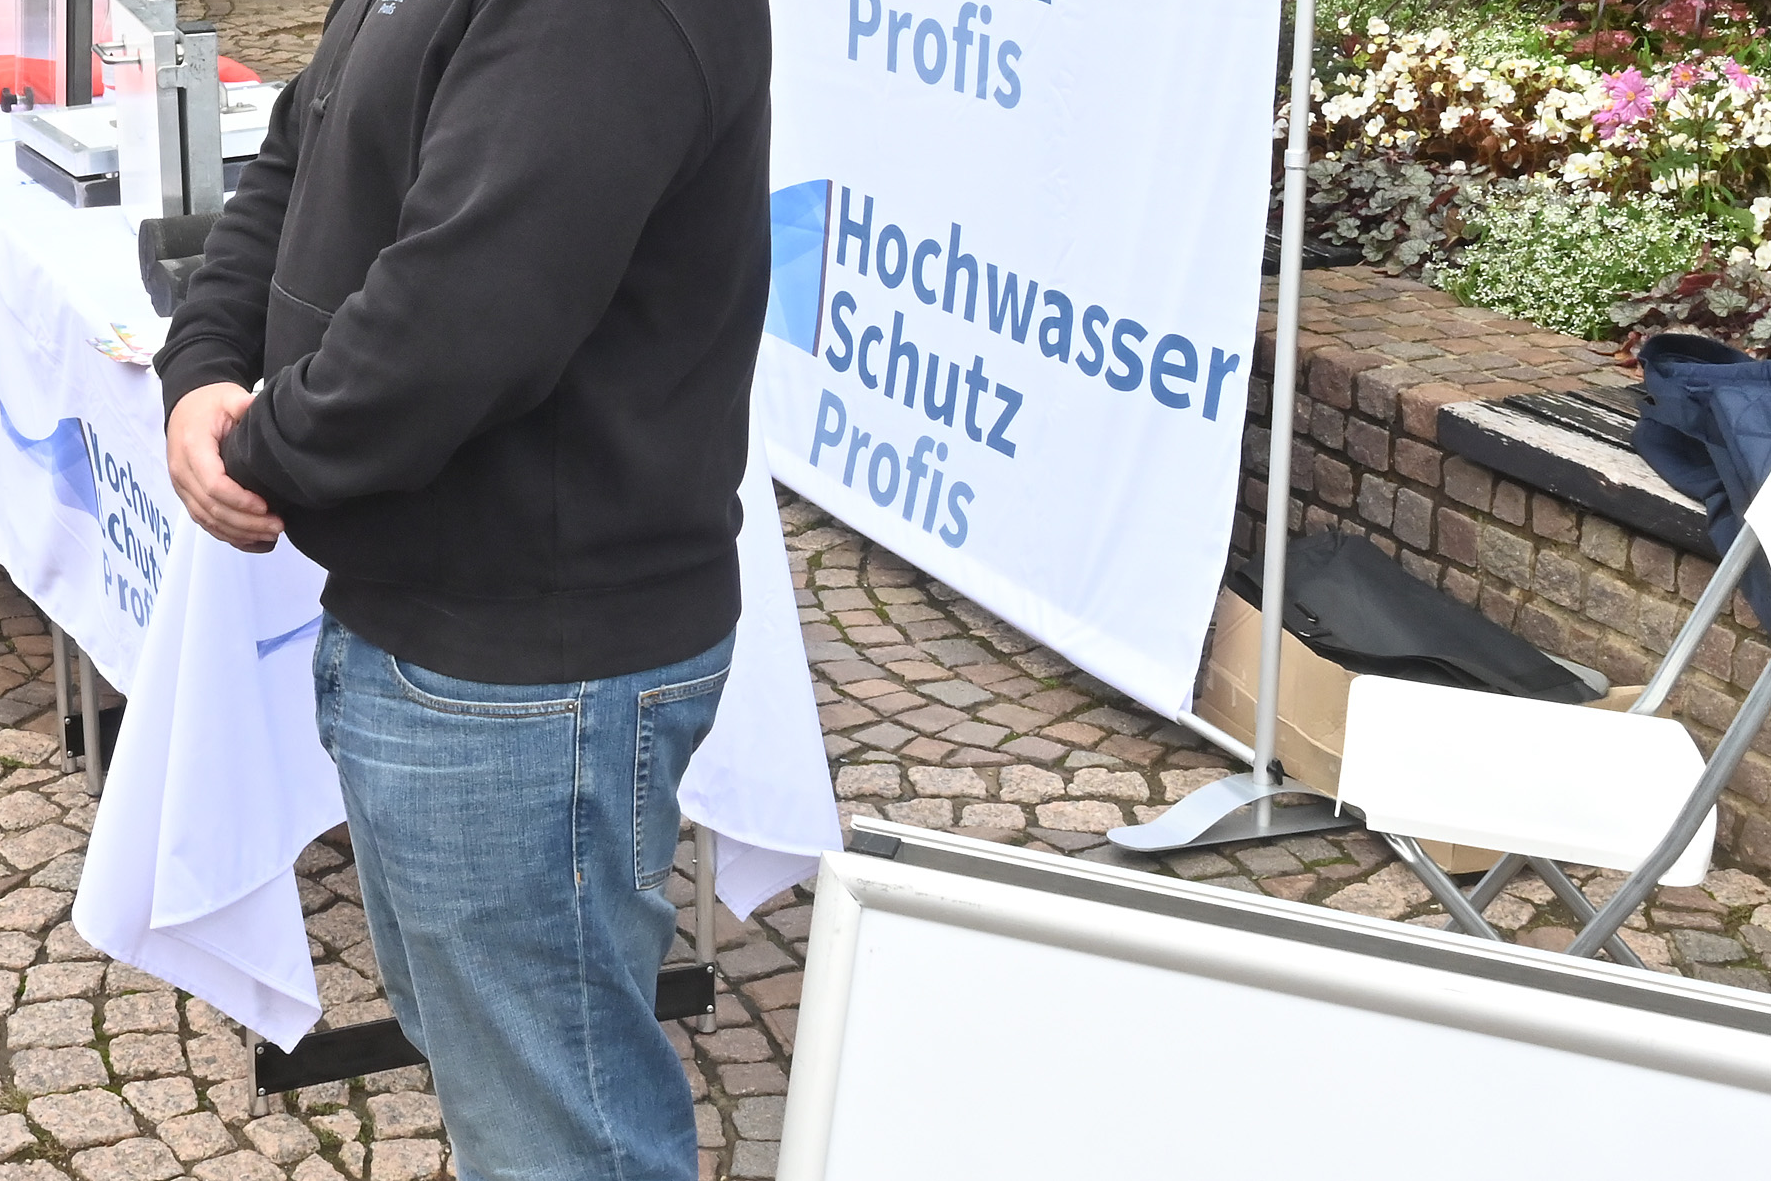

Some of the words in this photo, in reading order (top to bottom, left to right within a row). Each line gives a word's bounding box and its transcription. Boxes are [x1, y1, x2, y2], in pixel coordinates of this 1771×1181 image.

[825, 290, 1023, 459] Schutz
[837, 185, 1240, 422] Hochwasser
[87, 422, 172, 556] Hochwa
[97, 487, 163, 595] chut
[809, 388, 975, 549] Profis
